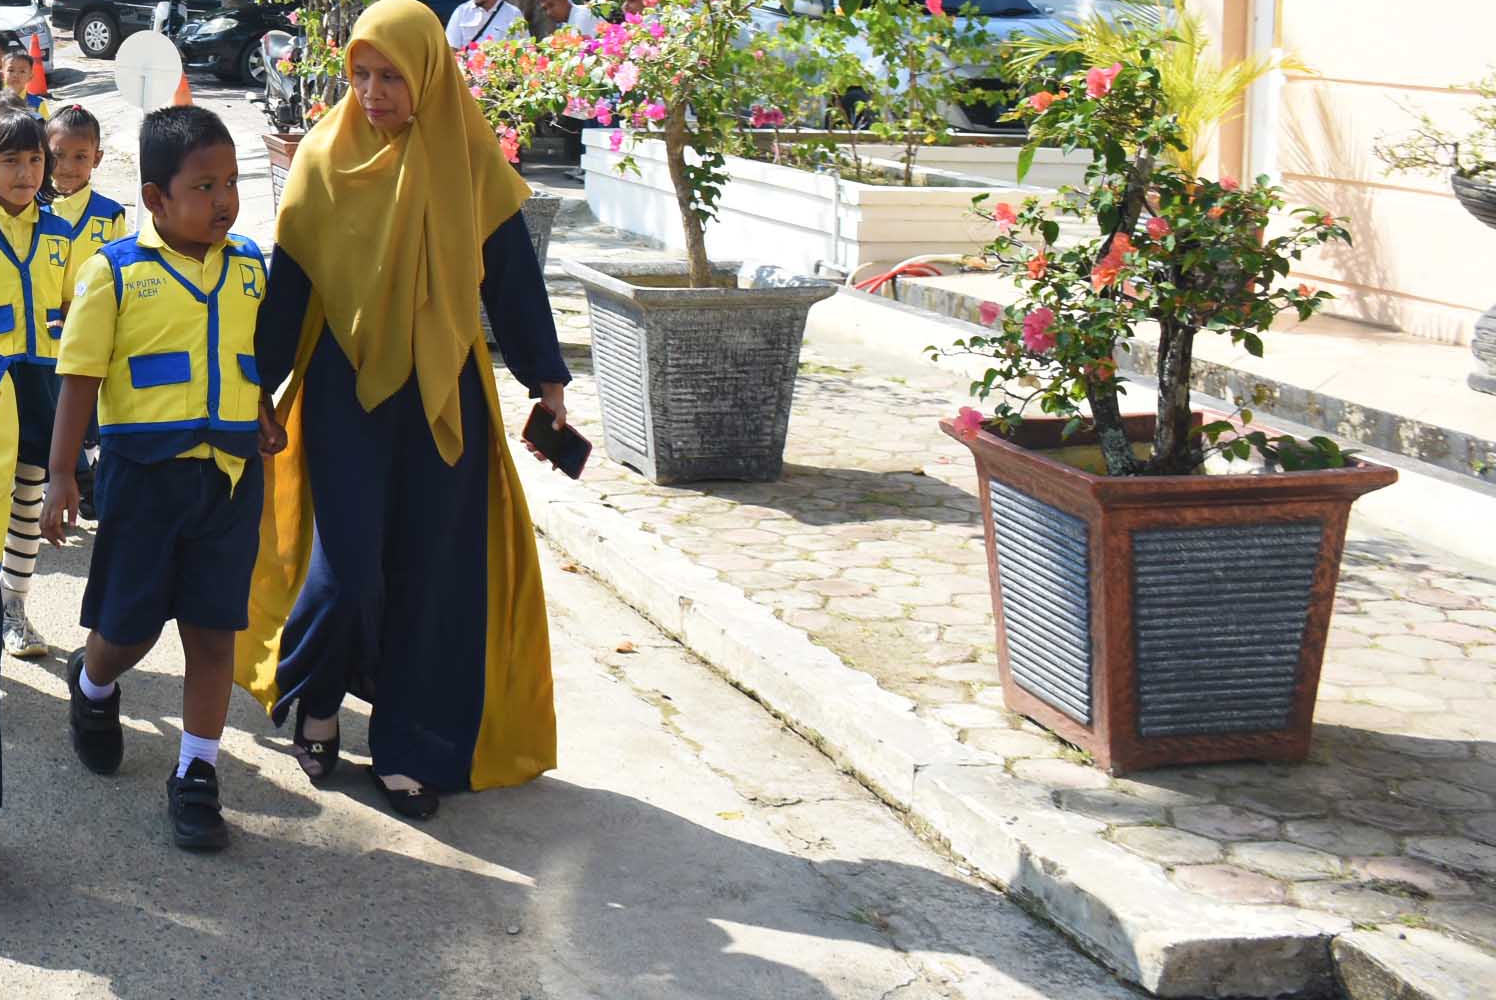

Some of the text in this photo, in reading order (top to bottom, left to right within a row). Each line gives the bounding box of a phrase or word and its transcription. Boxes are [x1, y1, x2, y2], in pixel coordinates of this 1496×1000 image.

[124, 283, 136, 292] TK
[136, 278, 161, 289] PUTRA
[137, 289, 158, 299] ACEH
